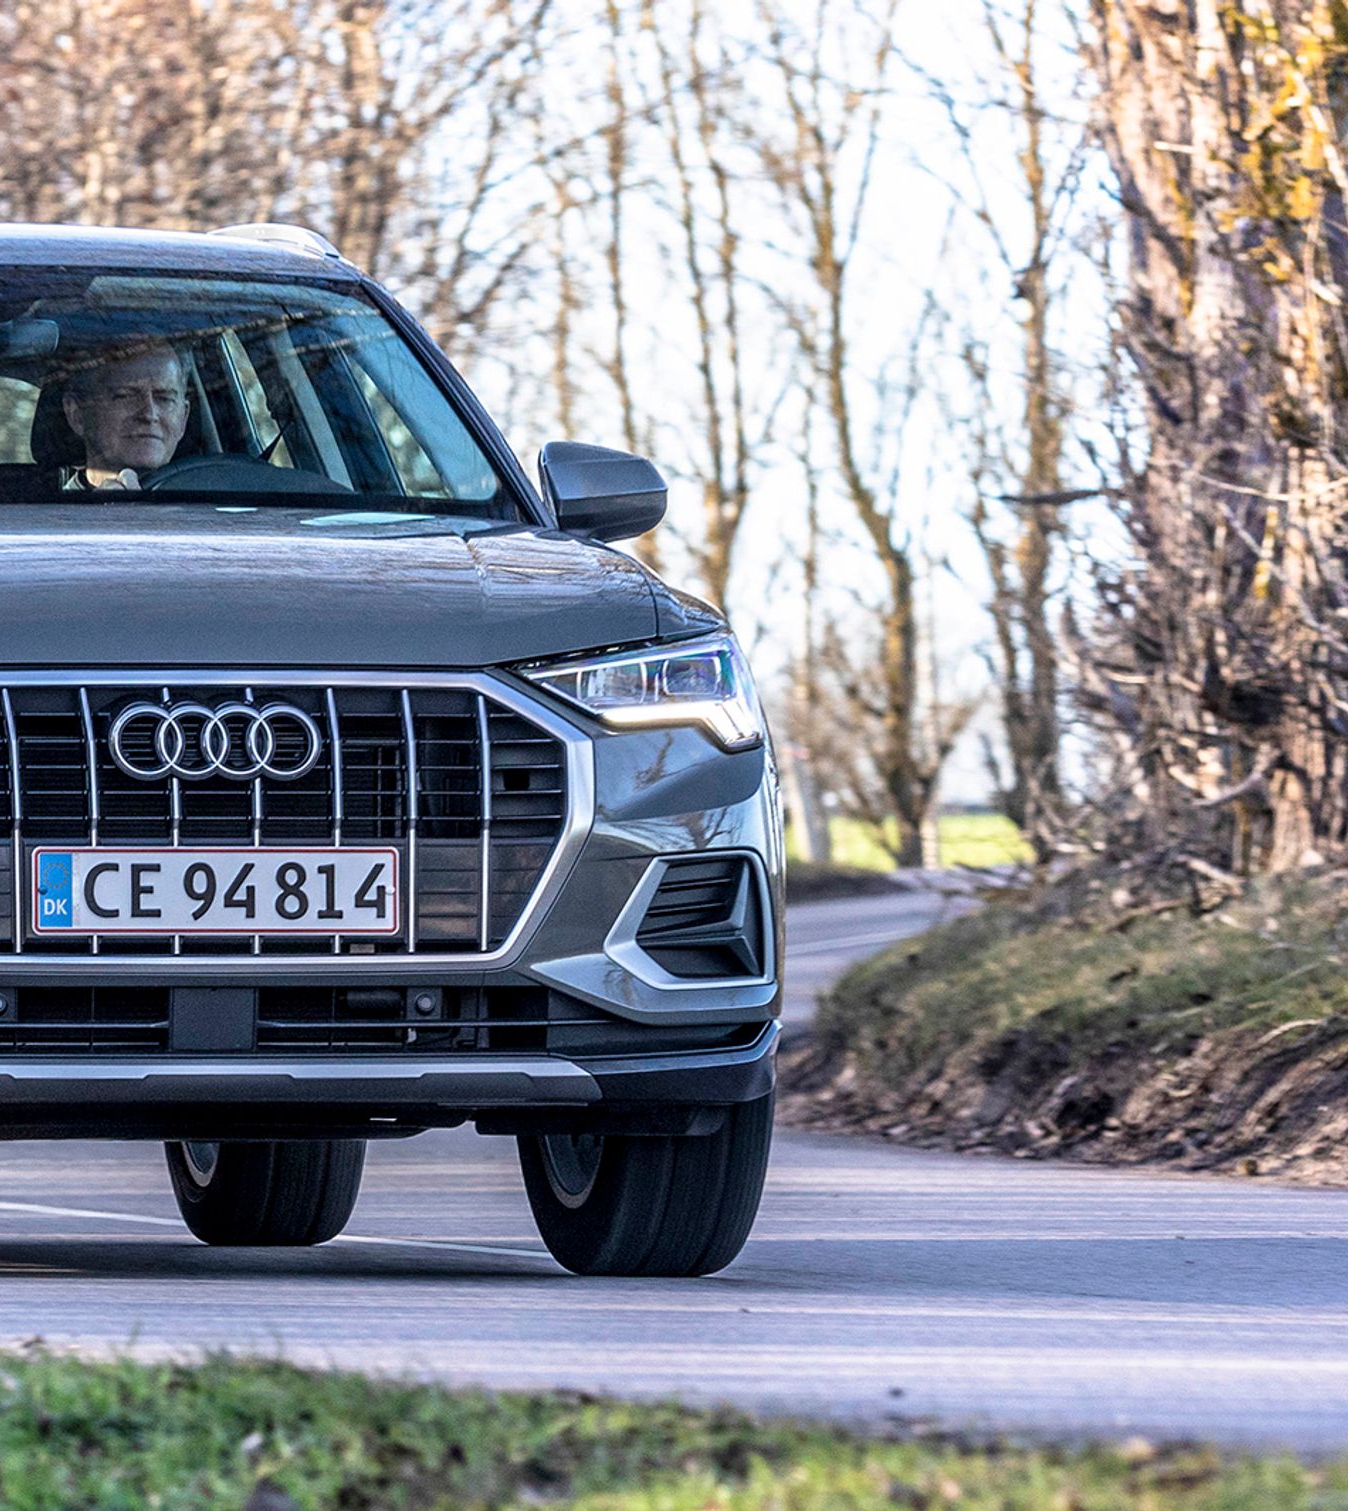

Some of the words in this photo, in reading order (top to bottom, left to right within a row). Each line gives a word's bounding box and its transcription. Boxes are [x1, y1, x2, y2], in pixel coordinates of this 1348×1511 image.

[43, 899, 68, 916] DK
[83, 862, 162, 919] CE
[182, 862, 256, 921] 94
[275, 862, 386, 920] 814
